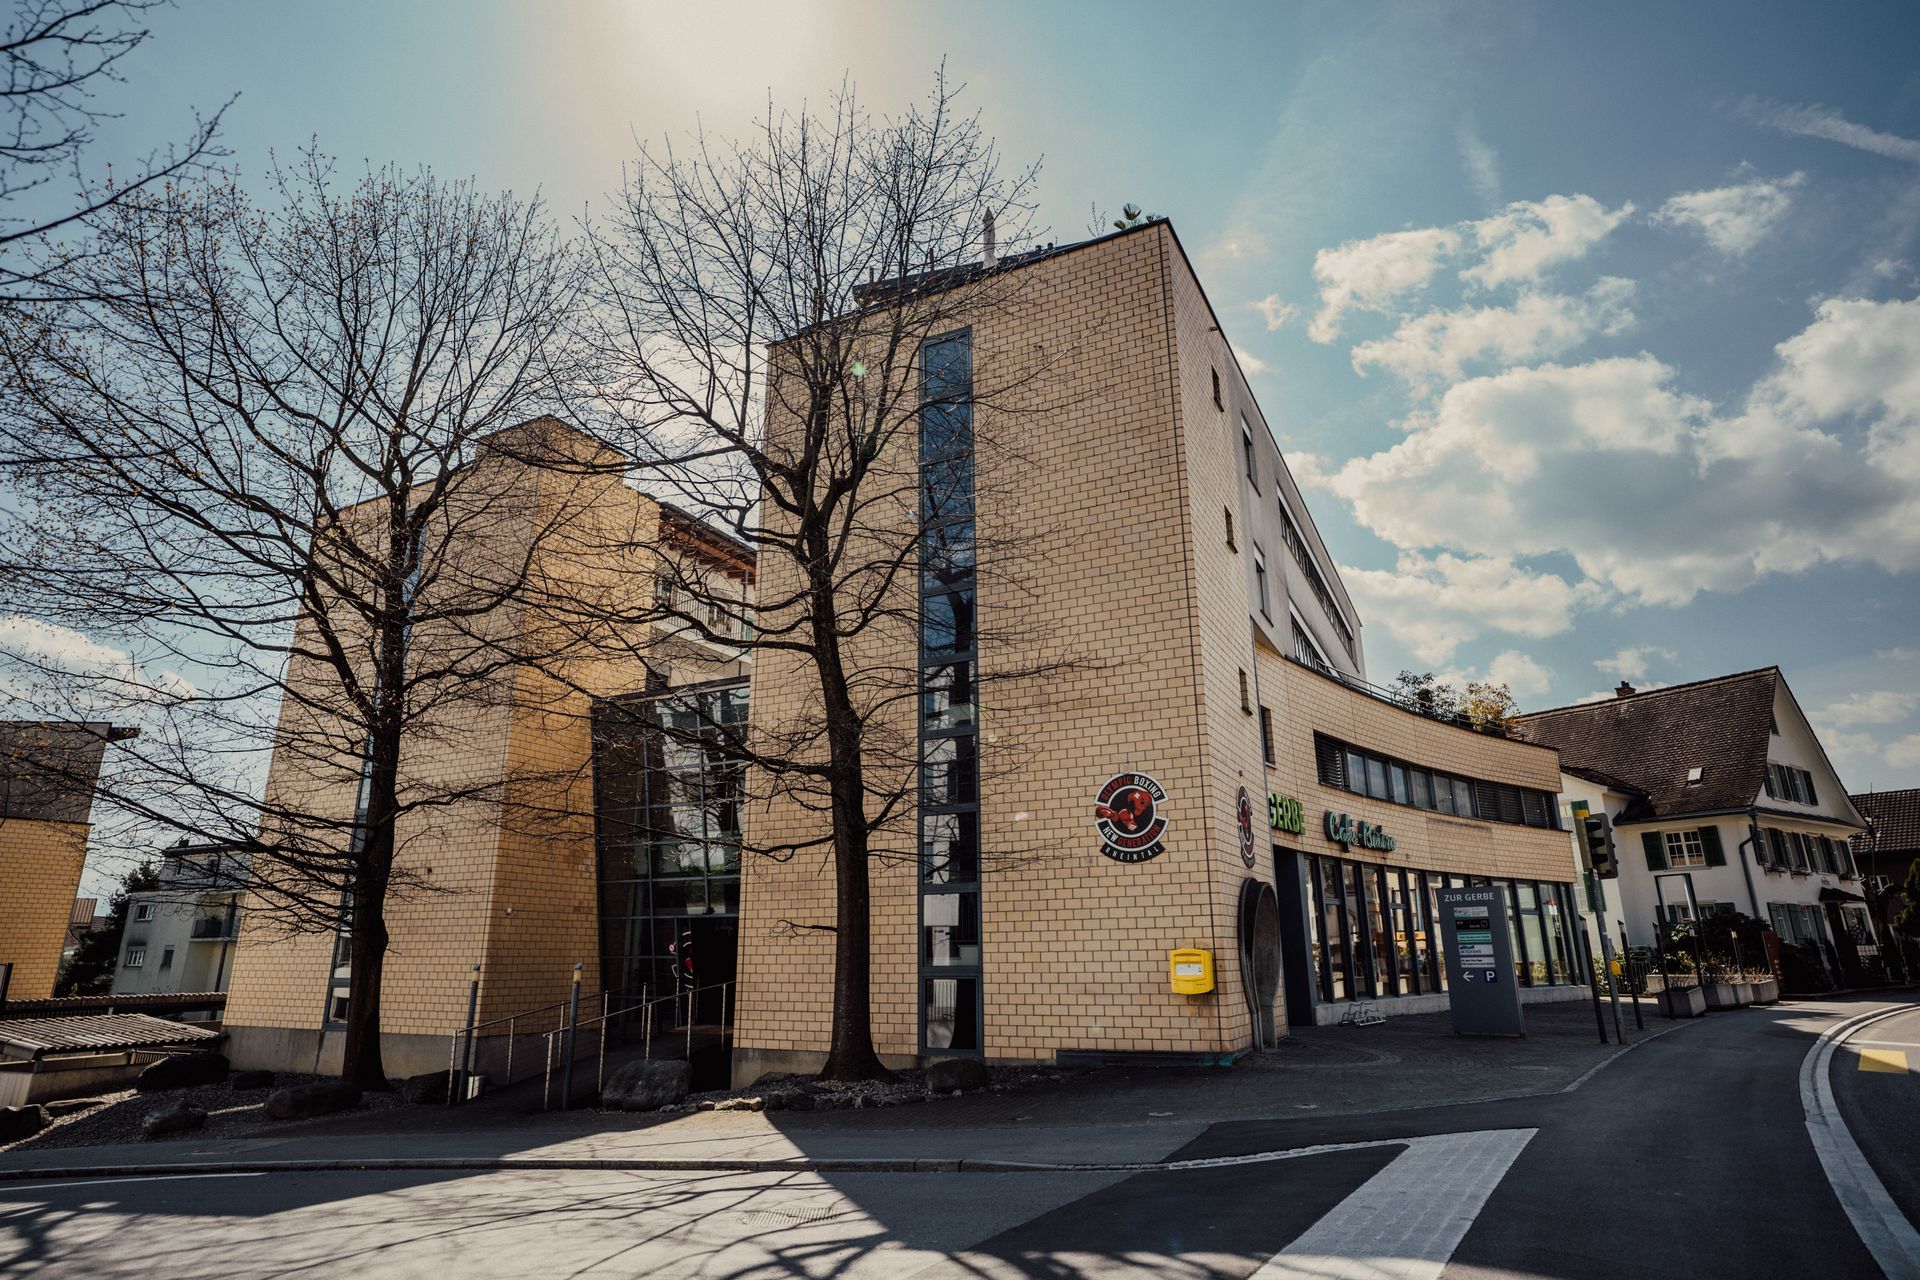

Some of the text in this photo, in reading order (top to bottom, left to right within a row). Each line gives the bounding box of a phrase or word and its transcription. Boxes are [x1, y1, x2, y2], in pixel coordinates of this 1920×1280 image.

[1101, 776, 1161, 800] OLYMPIC BOXING
[1268, 791, 1305, 834] GERBE
[1103, 824, 1161, 848] NEW GENERATION
[1105, 846, 1159, 860] RHEINTAL
[1444, 892, 1495, 902] ZUR GERBE
[1486, 971, 1495, 982] P
